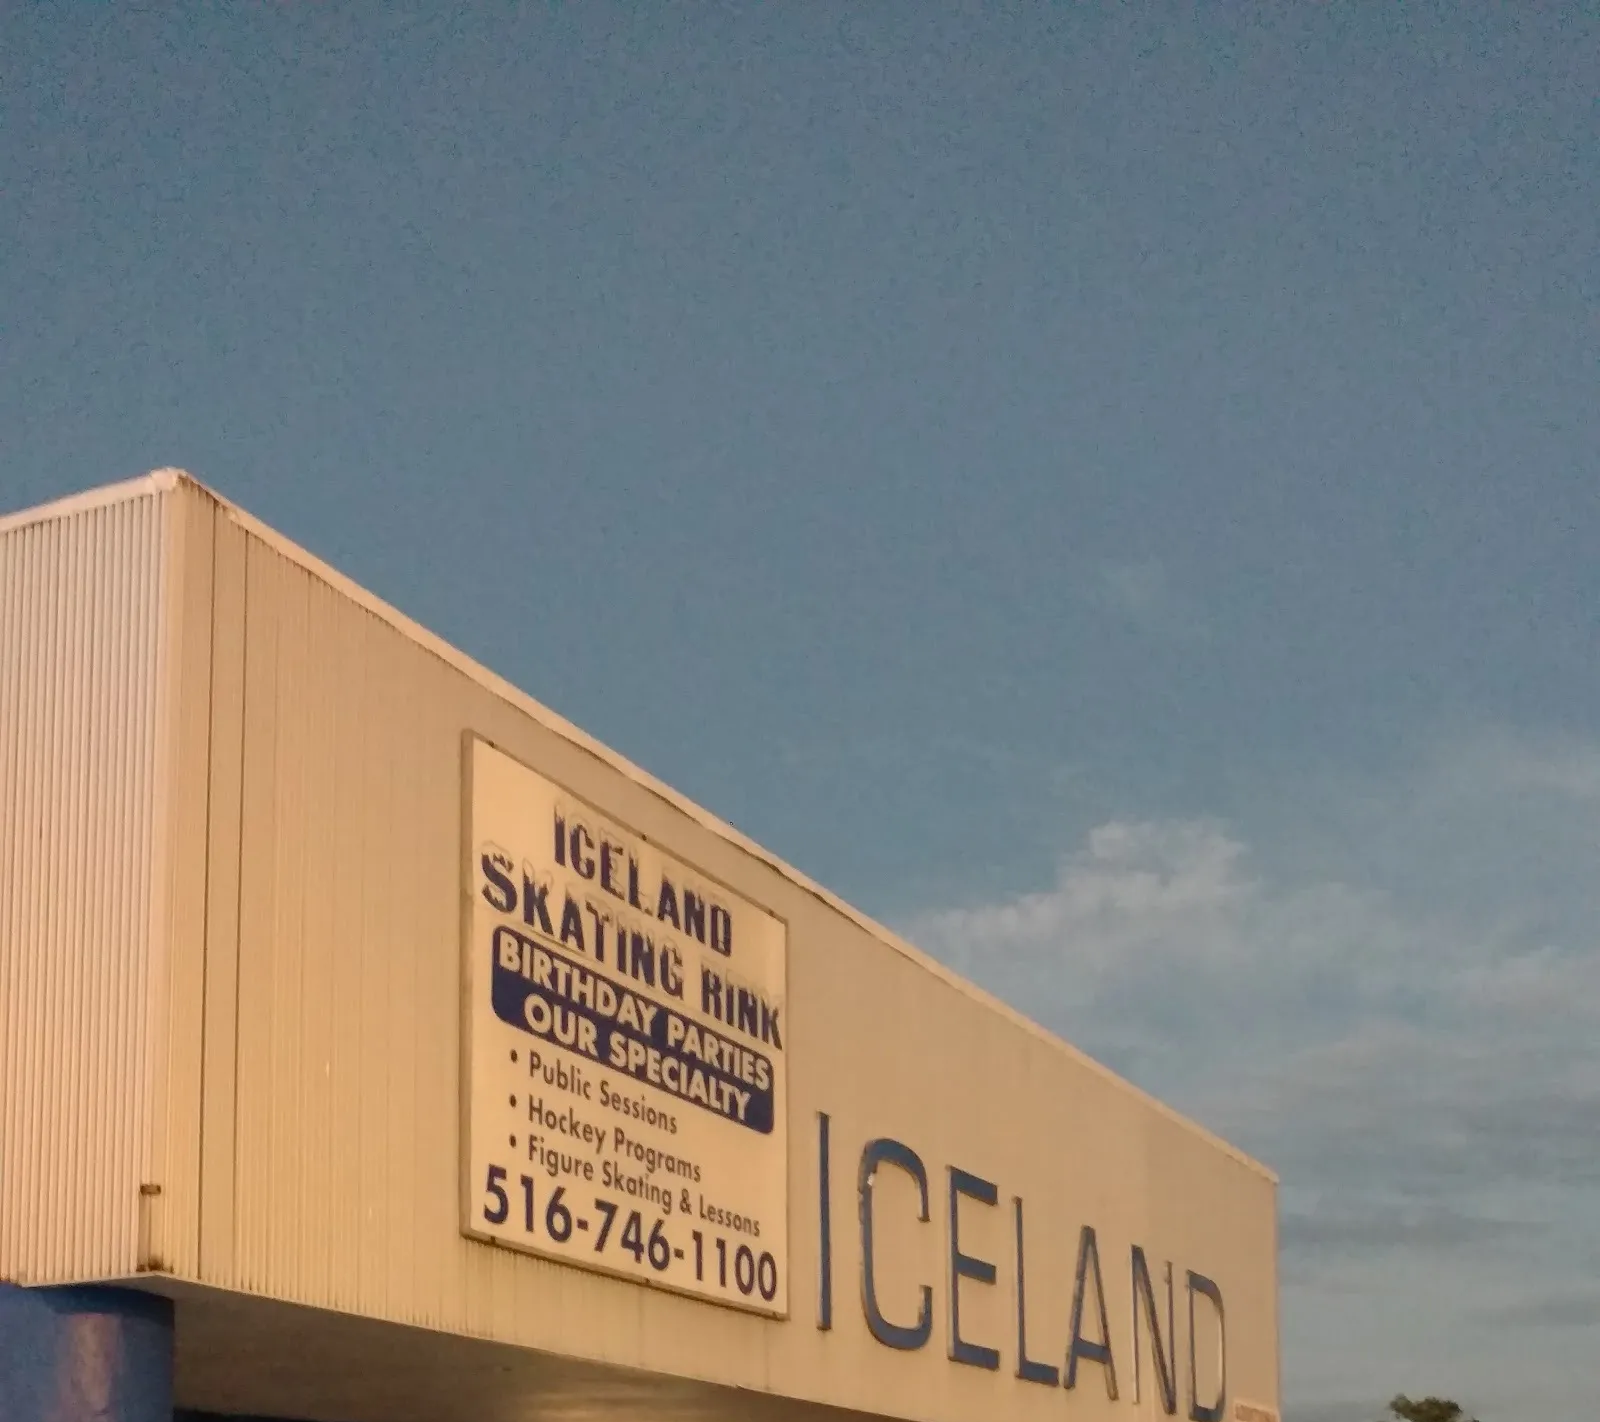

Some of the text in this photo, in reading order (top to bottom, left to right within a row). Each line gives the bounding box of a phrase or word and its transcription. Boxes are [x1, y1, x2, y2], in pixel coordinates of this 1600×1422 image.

[554, 804, 733, 957] ICELAND
[480, 848, 784, 1051] SKATING RINK
[499, 930, 771, 1091] BIRTHDAY PARTIES
[524, 993, 752, 1121] OUR SPECIALTY
[529, 1050, 678, 1134] Public Sessions
[528, 1094, 701, 1183] Hockey Programs
[528, 1134, 761, 1237] Figure Skating & Lessons
[483, 1163, 778, 1302] 516-746-1100
